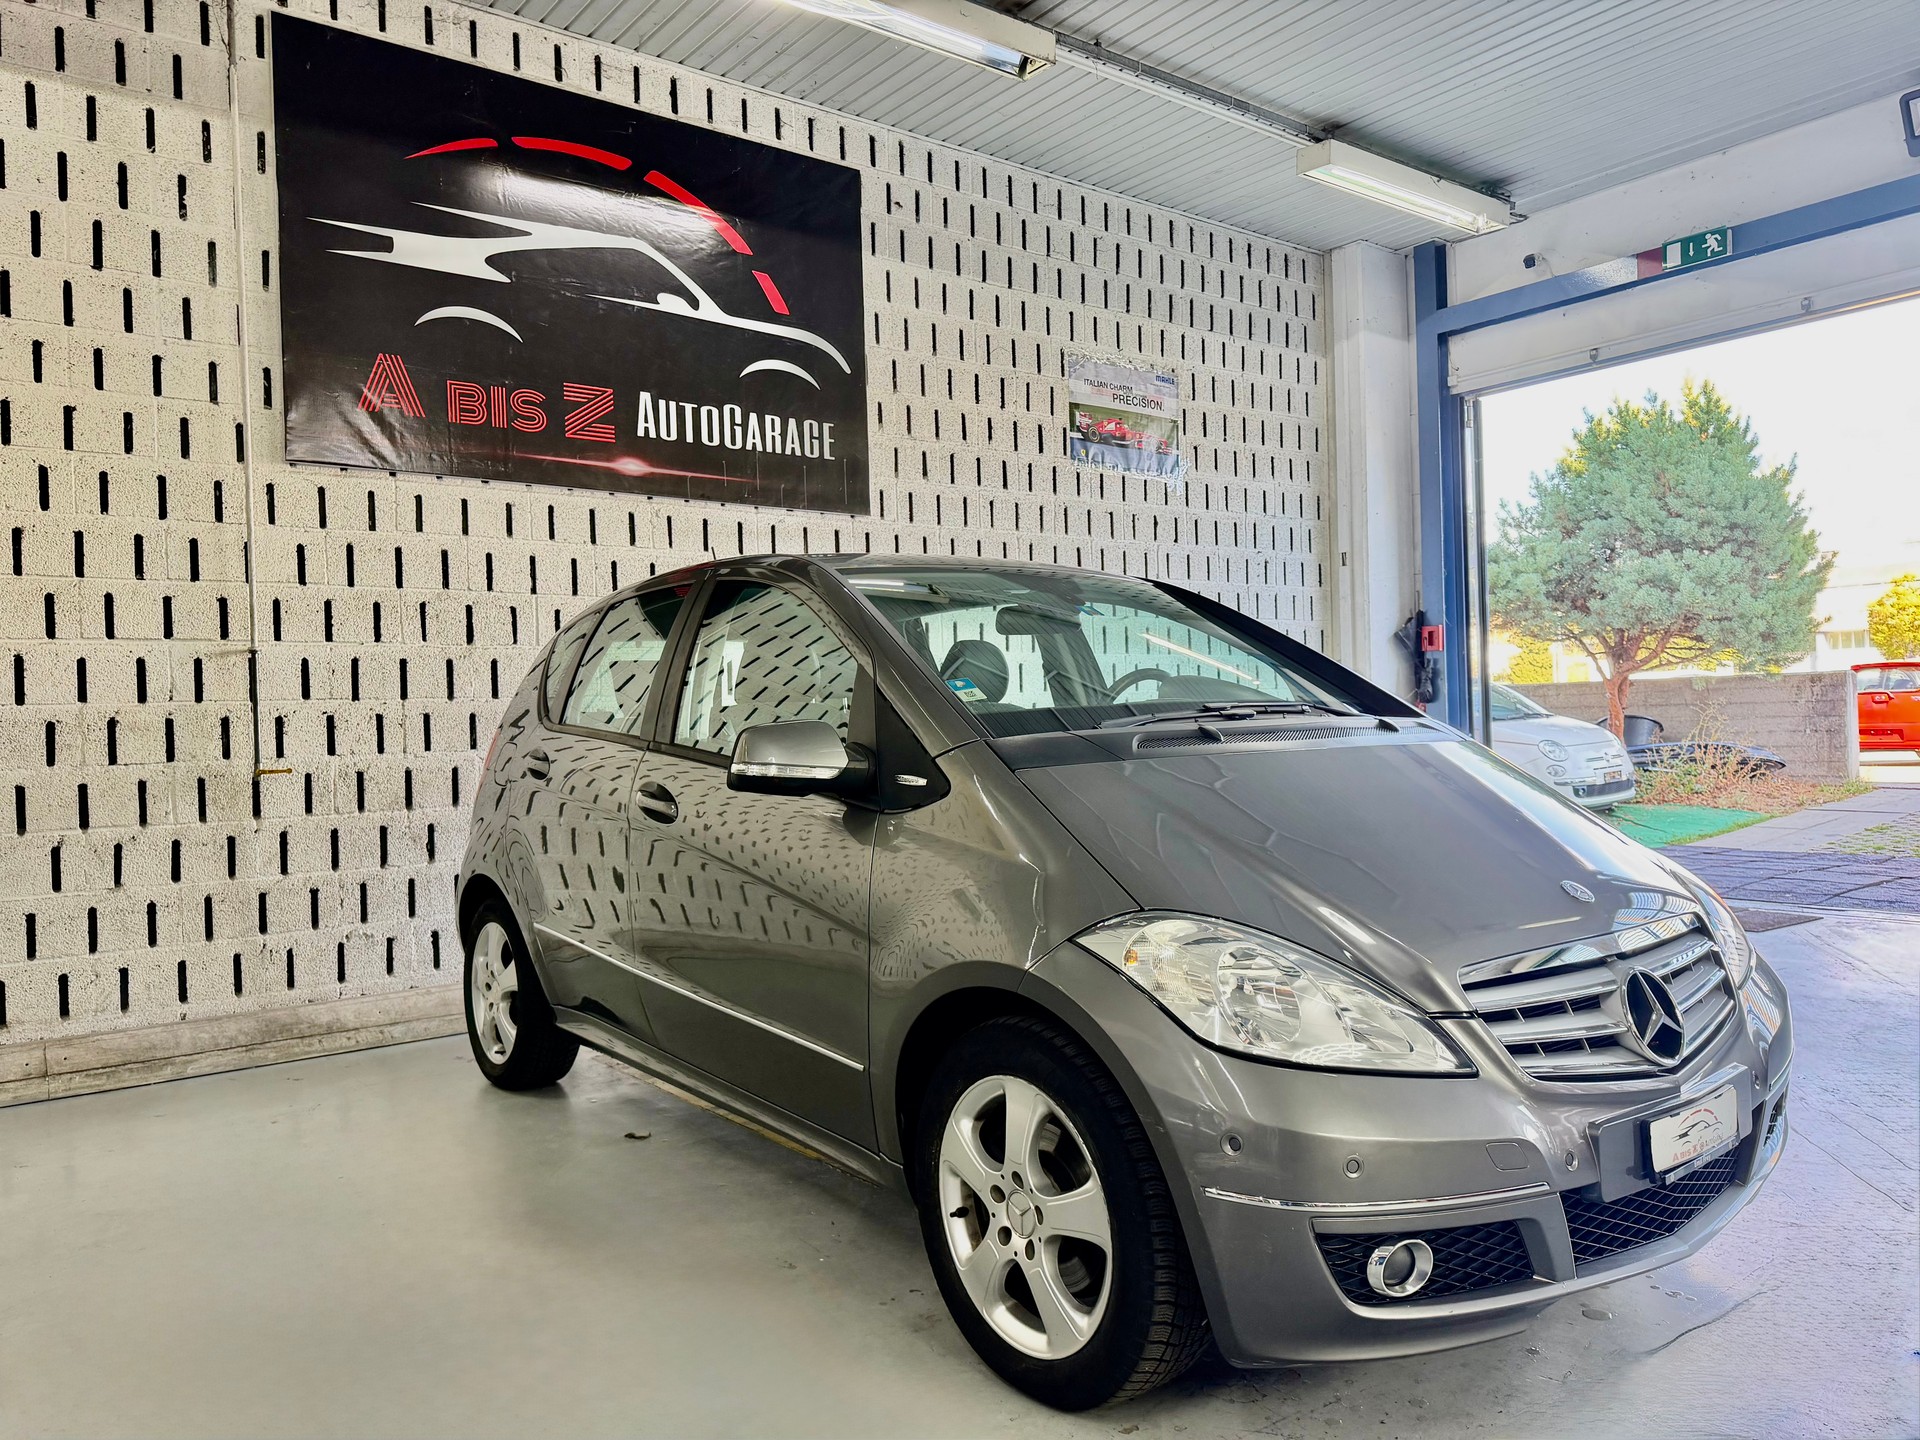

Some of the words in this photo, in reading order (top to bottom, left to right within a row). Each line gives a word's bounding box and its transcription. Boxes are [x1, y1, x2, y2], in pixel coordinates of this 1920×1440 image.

[1083, 378, 1109, 389] ITALIAN
[1109, 383, 1133, 392] CHARM
[357, 353, 426, 418] A
[446, 379, 548, 433] BIS
[563, 382, 616, 443] Z
[1112, 393, 1165, 412] PRECISION.
[1672, 1152, 1679, 1162] A
